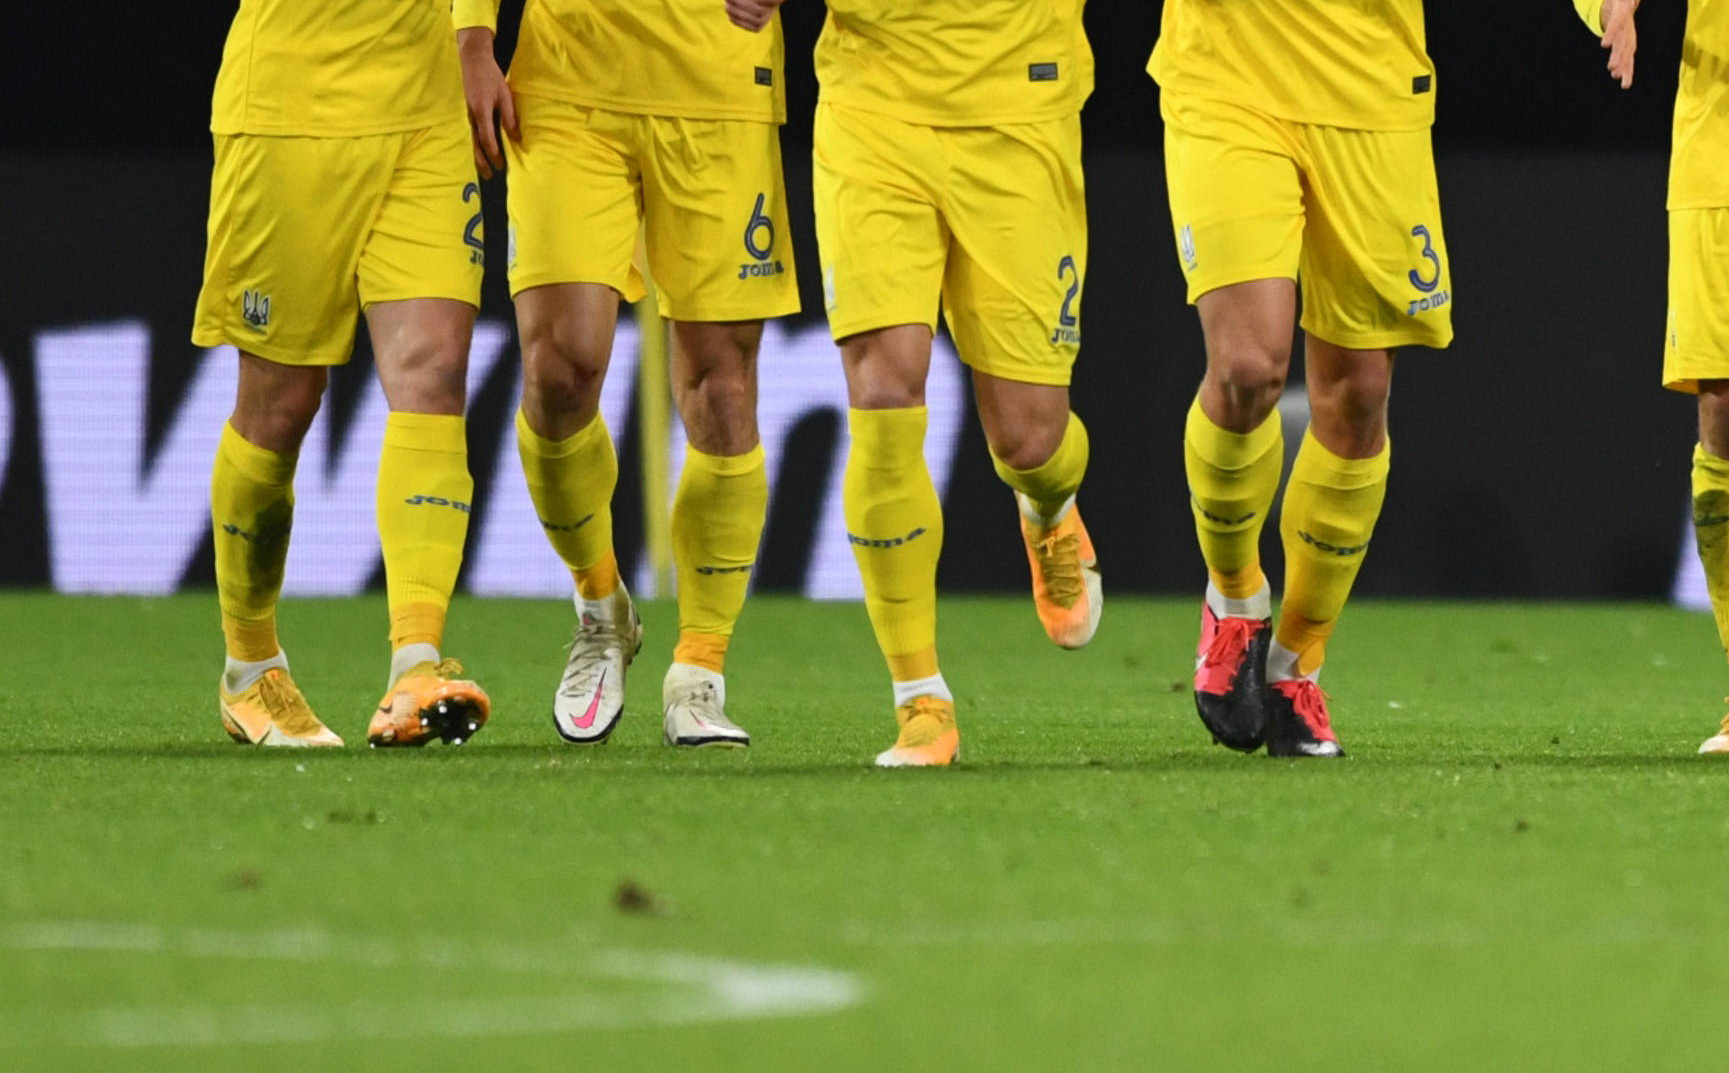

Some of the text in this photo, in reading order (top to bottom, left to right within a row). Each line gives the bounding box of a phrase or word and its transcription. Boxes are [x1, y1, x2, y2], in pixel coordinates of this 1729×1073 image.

[744, 193, 775, 261] 6
[1408, 225, 1440, 293] 3
[1058, 255, 1079, 327] 2
